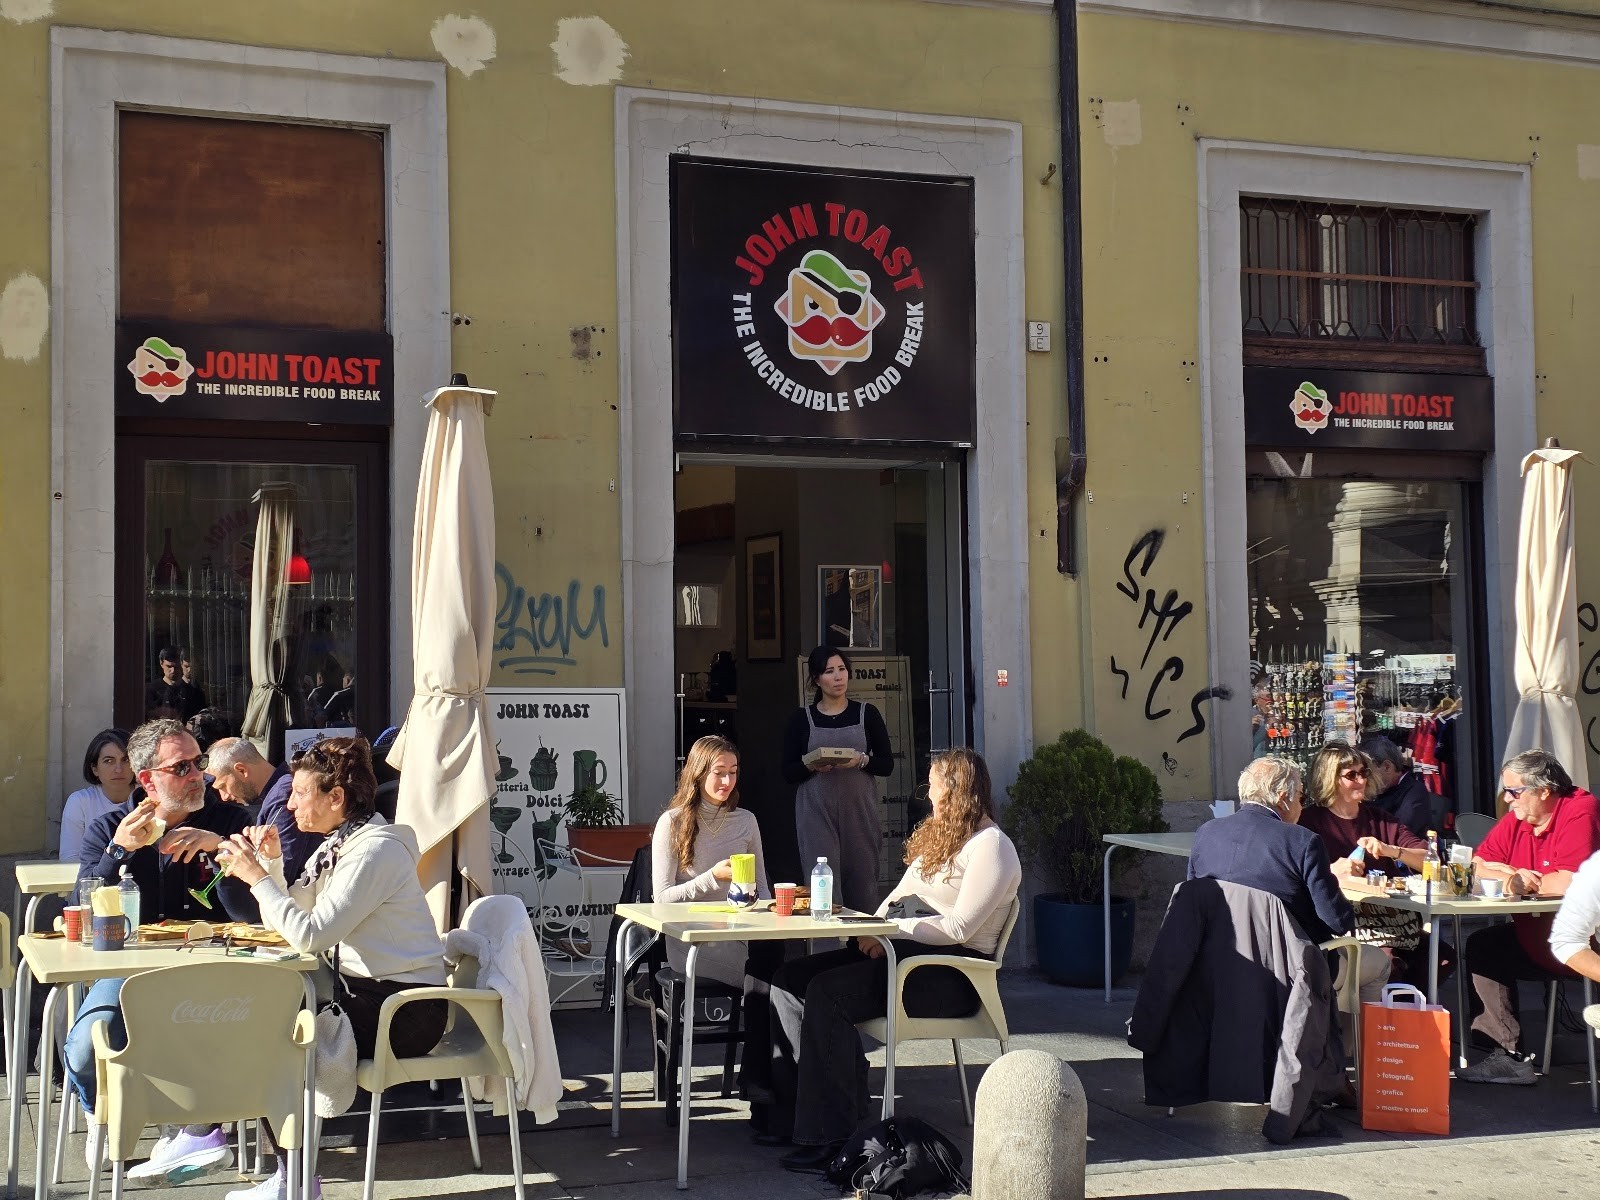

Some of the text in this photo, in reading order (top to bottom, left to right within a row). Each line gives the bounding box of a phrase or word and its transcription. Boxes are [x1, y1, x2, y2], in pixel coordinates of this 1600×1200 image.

[735, 202, 924, 292] JOHN TOAST
[1036, 323, 1044, 335] 9
[733, 292, 924, 412] THE INCREDIBLE FOOD BREAK
[196, 351, 381, 385] JOHN TOAST
[196, 382, 381, 401] THE INCREDIBLE FOOD BREAK
[1334, 391, 1454, 417] JOHN TOAST
[1334, 417, 1454, 431] THE INCREDIBLE FOOD BREAK
[497, 703, 590, 720] JOHN TOAST
[526, 794, 563, 808] Dolci
[566, 903, 616, 918] GLUTIN
[1382, 1041, 1420, 1050] architettura
[1382, 1057, 1404, 1065] design
[1381, 1072, 1414, 1082] fotografia
[1381, 1088, 1404, 1097] grafica
[1410, 1105, 1429, 1114] musei
